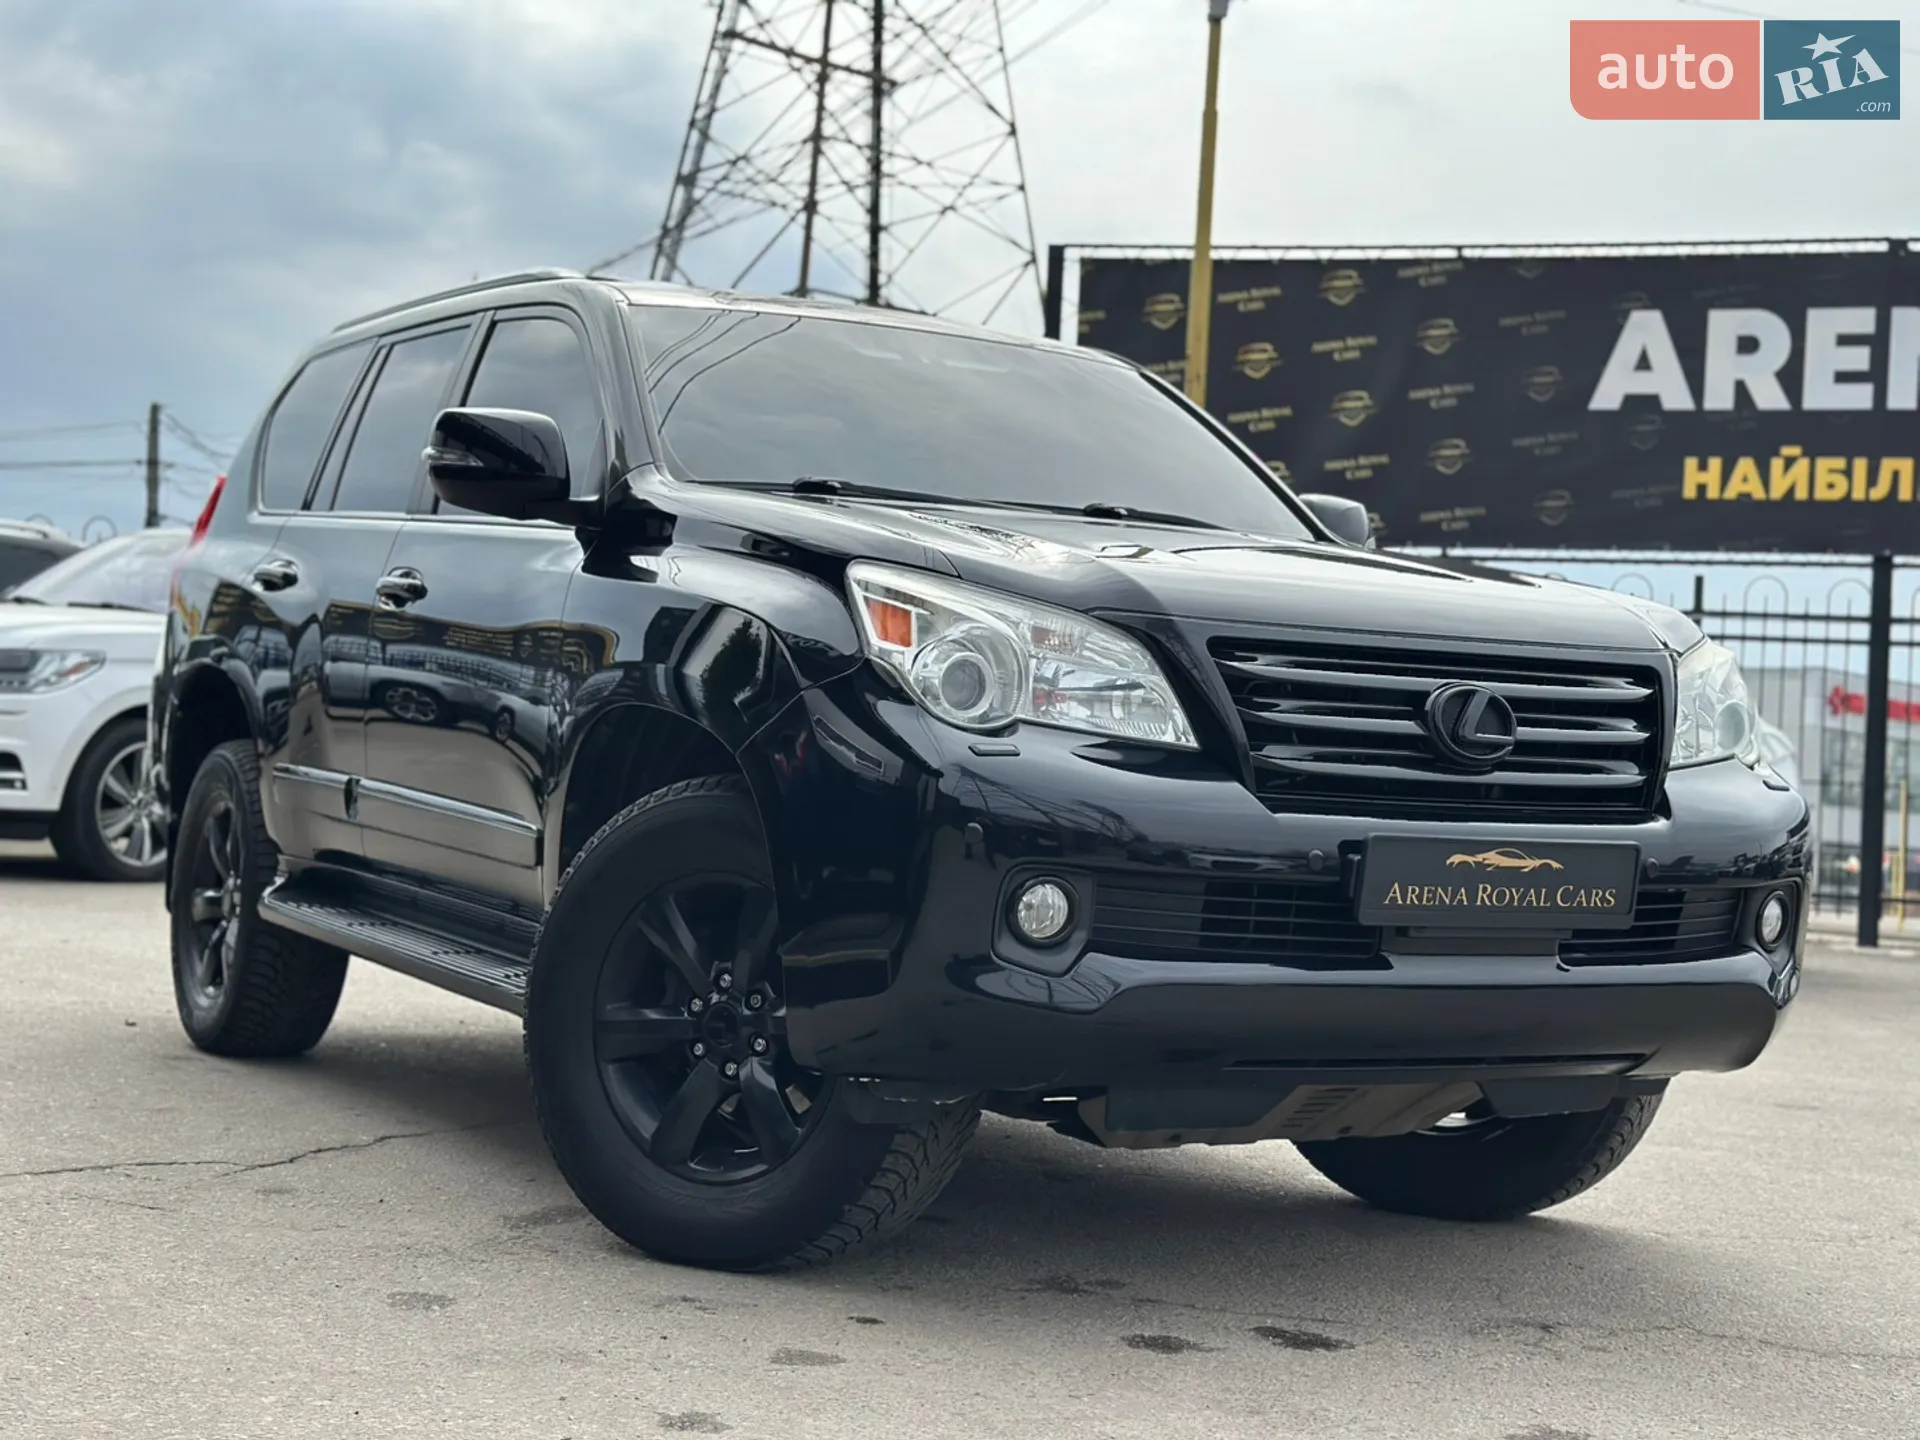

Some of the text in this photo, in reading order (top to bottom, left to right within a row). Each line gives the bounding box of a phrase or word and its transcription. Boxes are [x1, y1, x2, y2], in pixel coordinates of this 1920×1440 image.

[1682, 445, 1920, 502] НАЙБІЛ
[1383, 881, 1617, 908] ARENA ROYAL CARS
